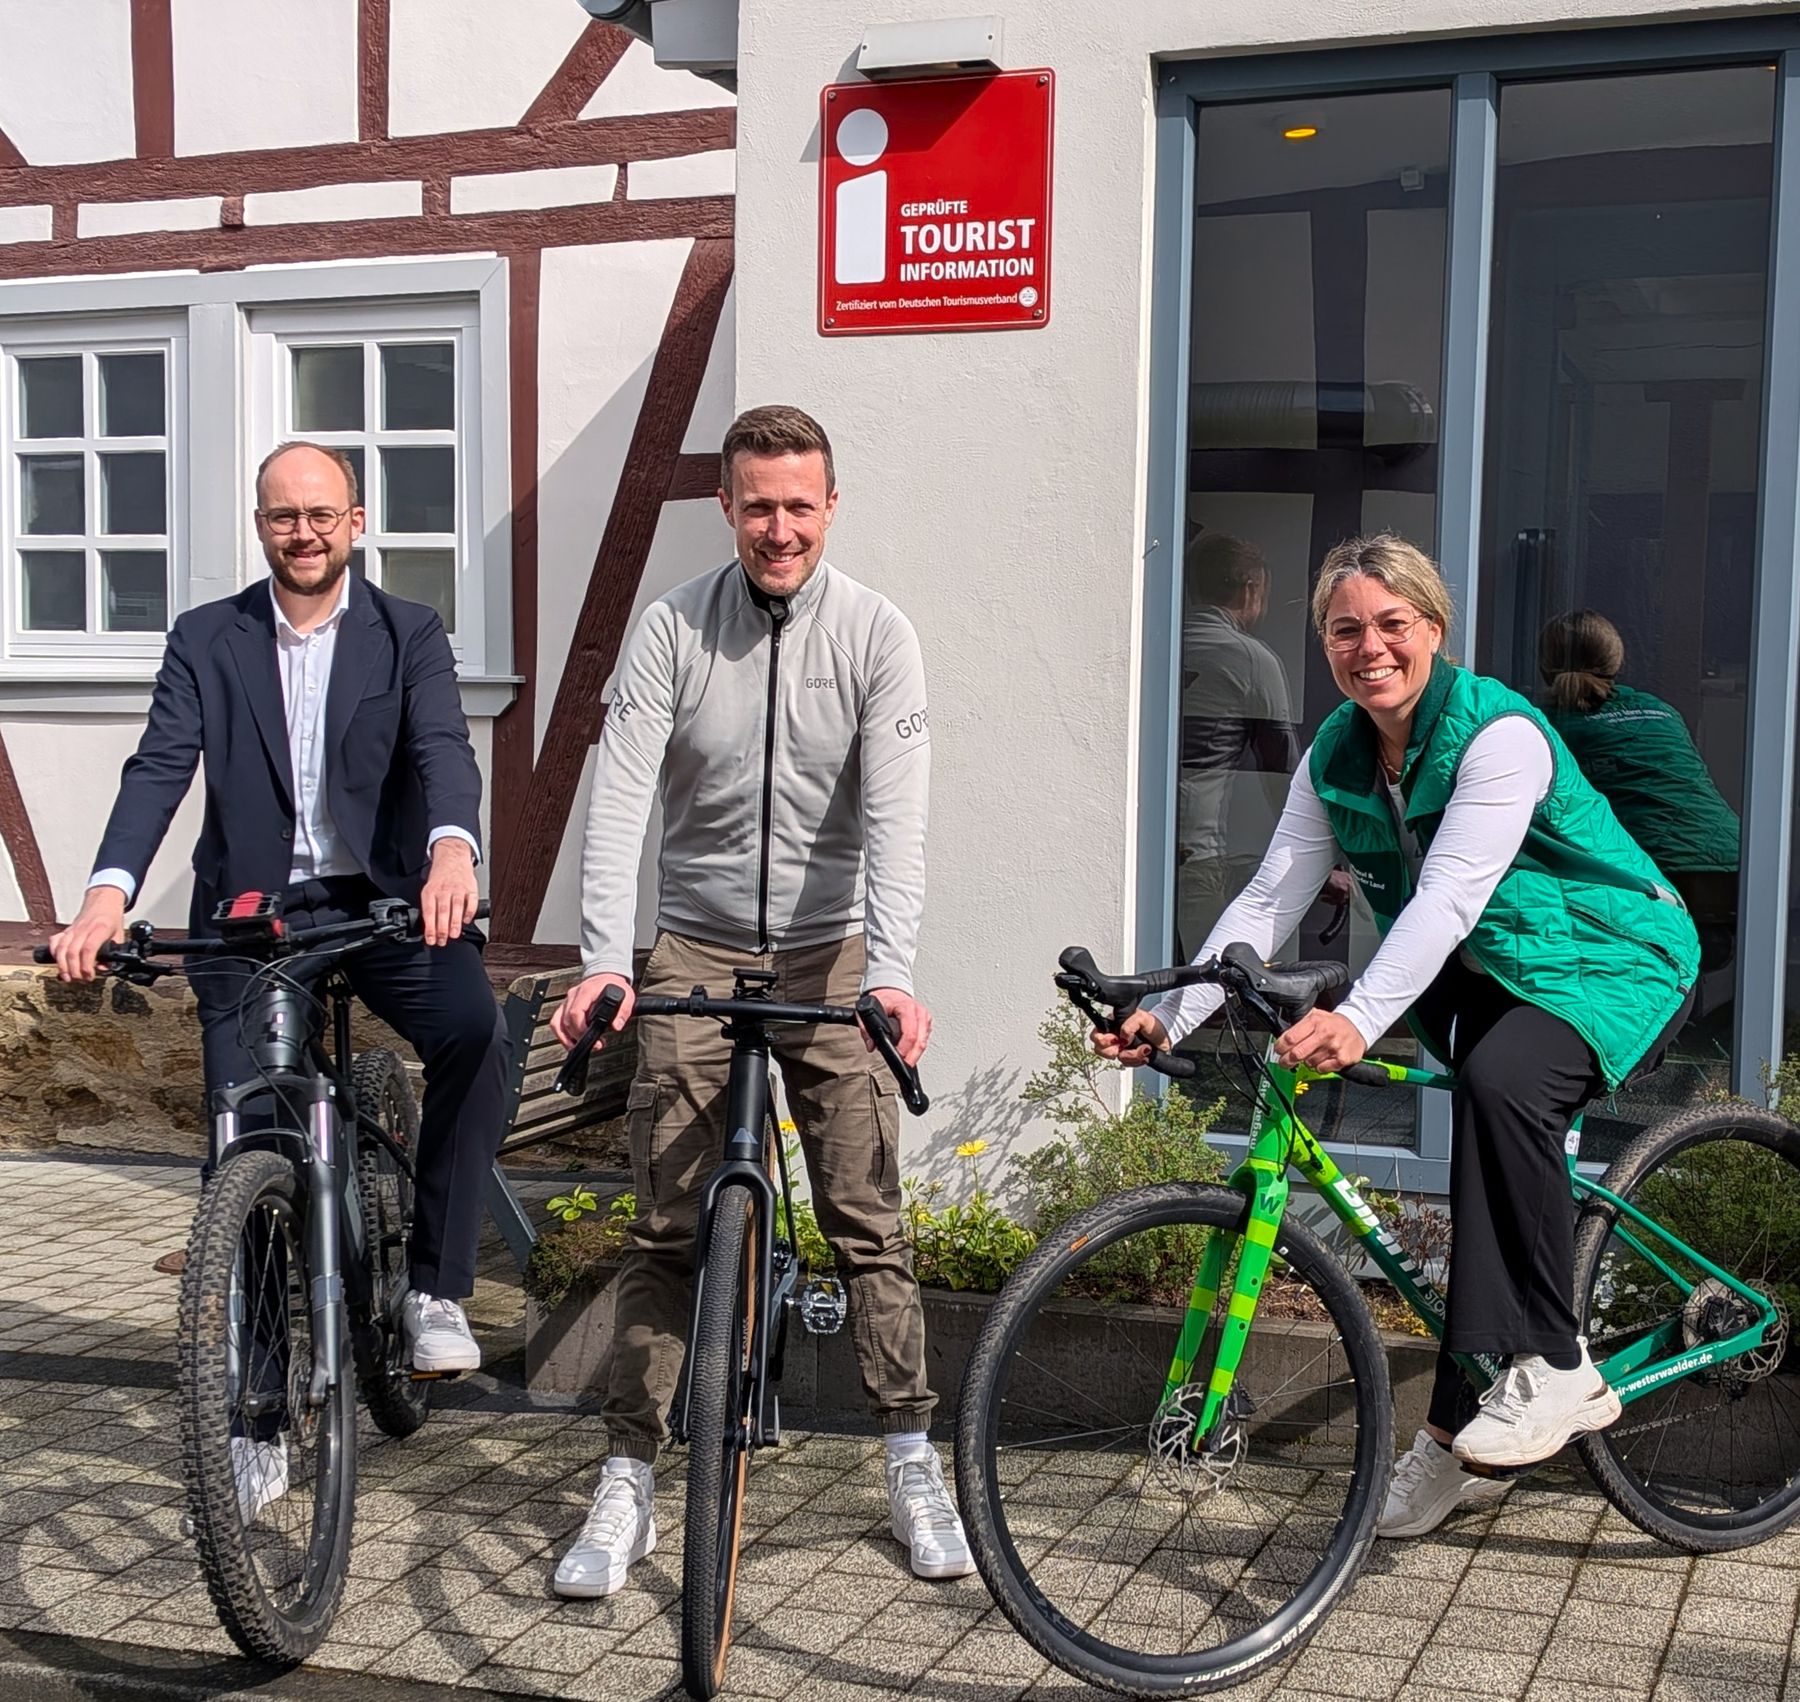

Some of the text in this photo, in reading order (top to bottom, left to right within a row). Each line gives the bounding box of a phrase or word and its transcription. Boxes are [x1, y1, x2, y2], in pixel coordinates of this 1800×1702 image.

[901, 198, 968, 217] GEPRÜFTE
[901, 218, 1035, 254] TOURIST
[900, 257, 1034, 281] INFORMATION
[836, 300, 877, 311] Zertifiziert
[879, 301, 897, 309] vom
[899, 296, 941, 308] Deutschen
[943, 293, 1017, 306] Tourismusverband
[806, 677, 836, 689] GORE
[611, 687, 636, 723] RE
[895, 707, 929, 739] GOR
[1258, 1193, 1282, 1215] W
[1210, 1641, 1282, 1680] CROSSCUT
